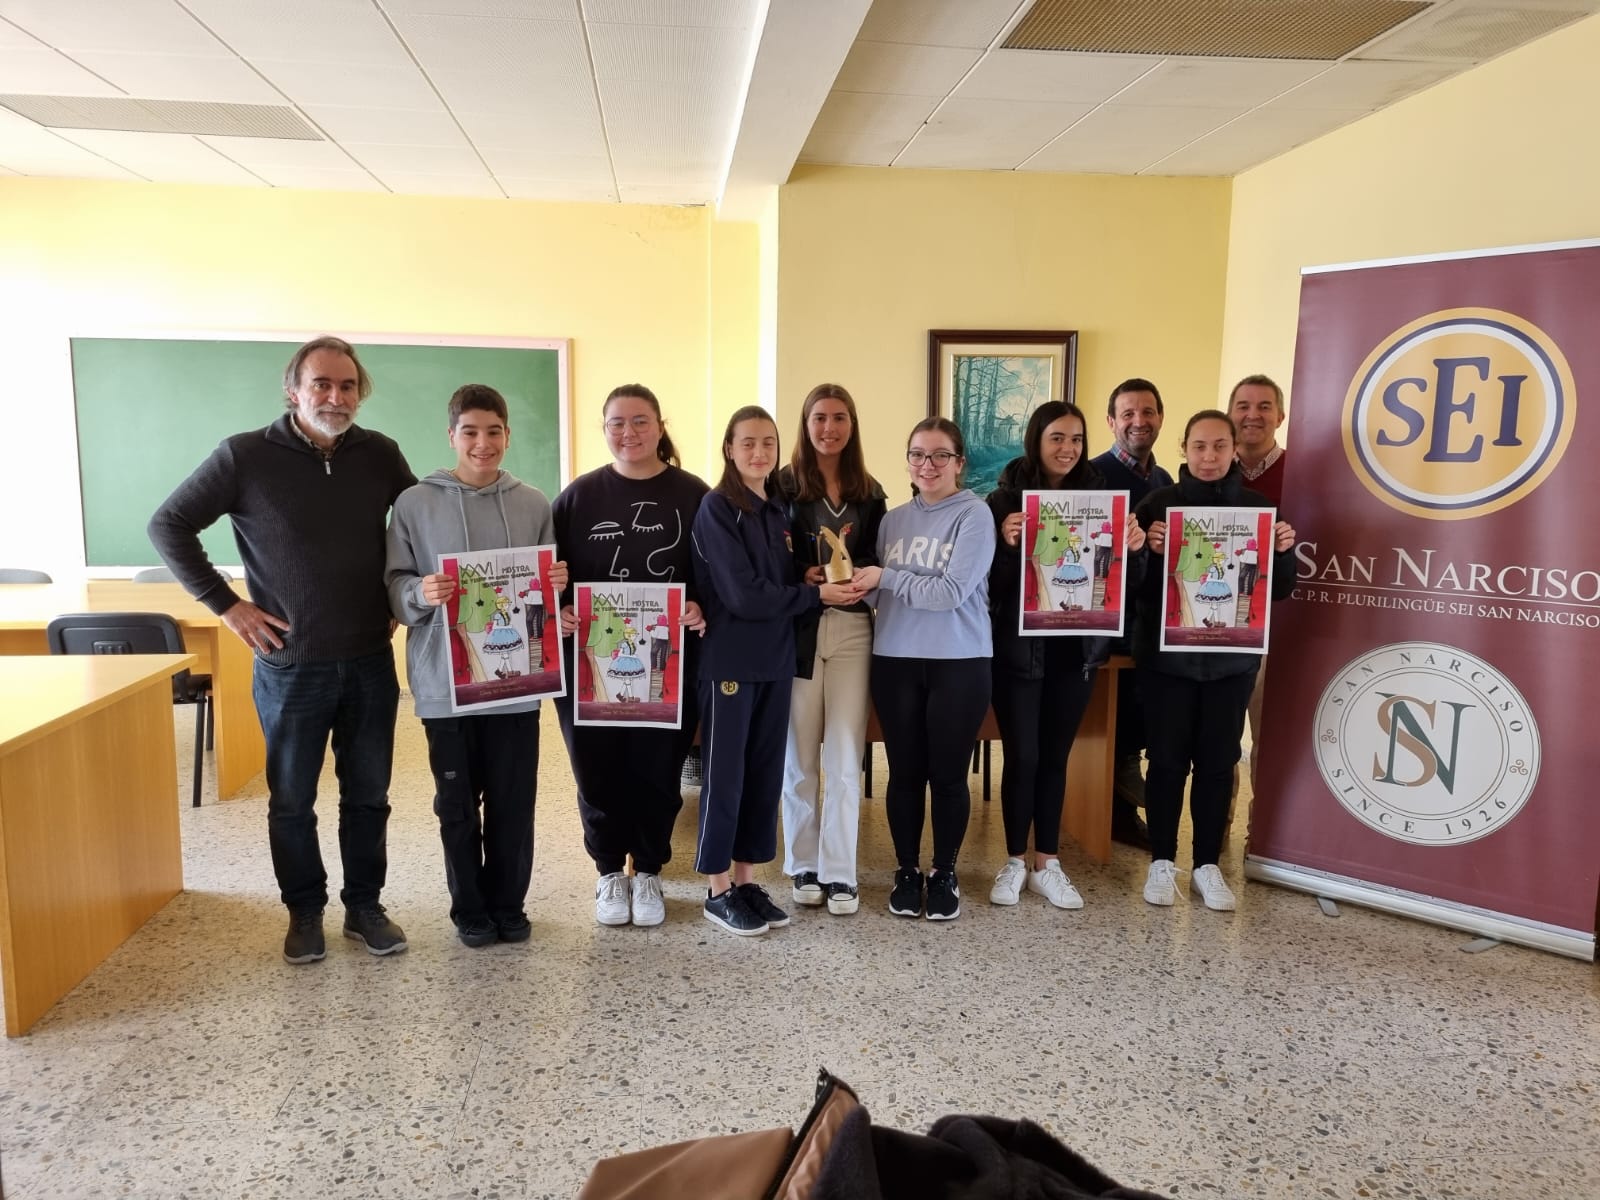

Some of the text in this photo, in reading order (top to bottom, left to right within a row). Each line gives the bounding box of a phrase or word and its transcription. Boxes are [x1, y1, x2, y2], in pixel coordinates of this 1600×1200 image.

[1376, 356, 1528, 463] SEI
[1040, 501, 1104, 516] XXVI MOSTRA
[1184, 517, 1250, 533] XXVI MOSTRA
[883, 536, 954, 569] ARIS
[458, 561, 495, 579] XXVI
[501, 564, 530, 575] MOSTRA
[592, 592, 659, 608] XXVI MOSTRA
[1337, 592, 1445, 614] PLURILINGÜE
[1448, 602, 1474, 617] SEI
[1477, 605, 1513, 620] SAN
[1517, 608, 1600, 629] NARCISO
[1331, 652, 1524, 733] SAN NARCISO
[1332, 768, 1507, 836] SINCE 1926
